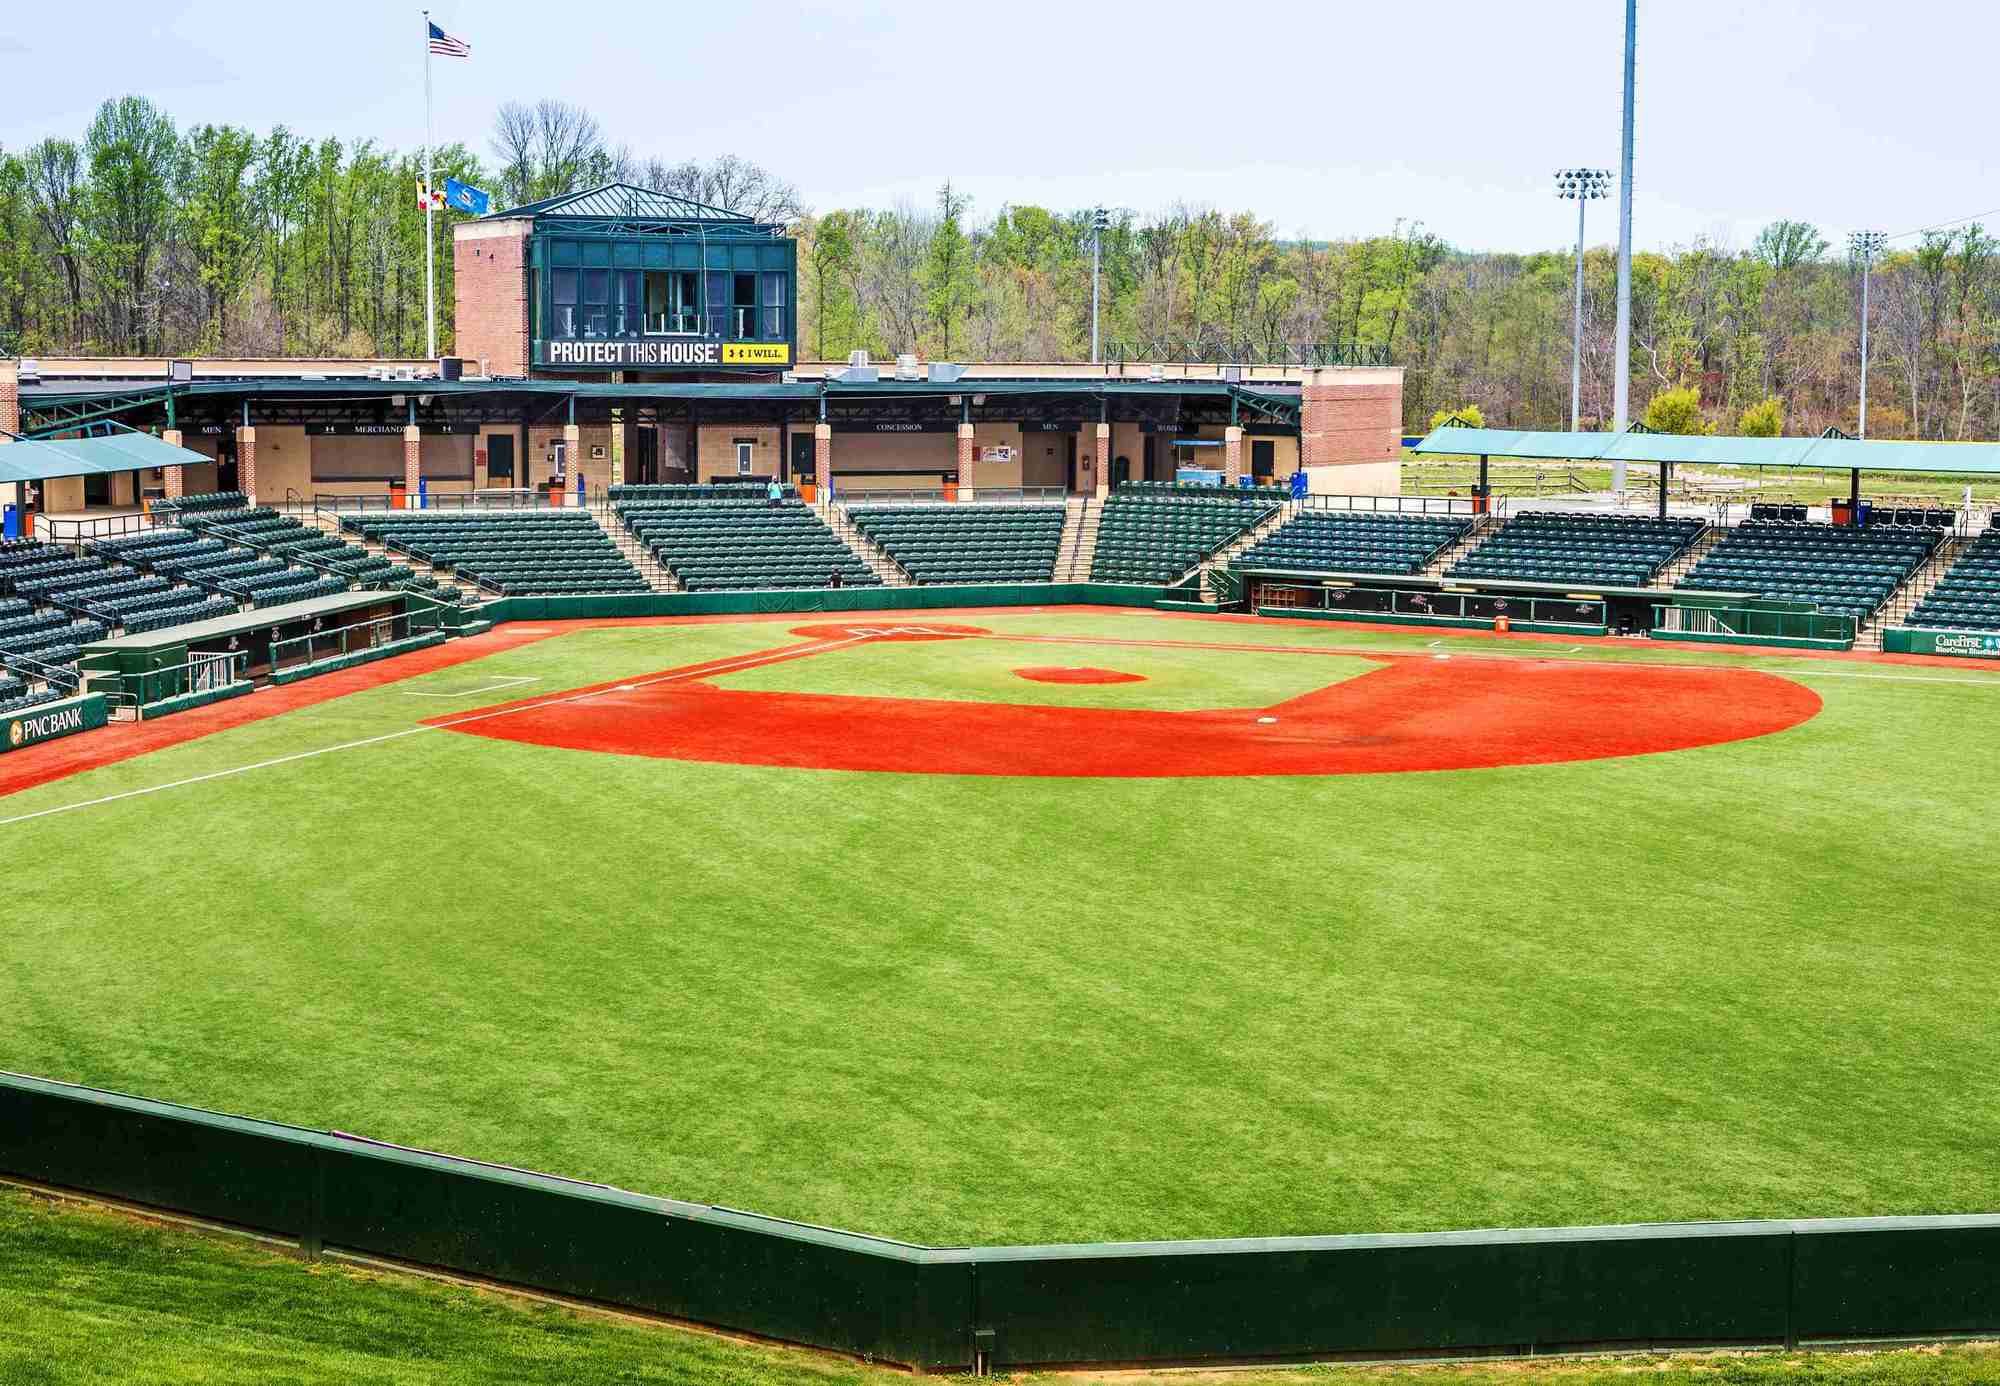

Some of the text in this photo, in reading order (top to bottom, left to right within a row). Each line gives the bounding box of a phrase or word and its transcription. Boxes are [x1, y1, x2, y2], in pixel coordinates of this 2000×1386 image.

[550, 342, 625, 363] PROTECT
[628, 342, 657, 363] THIS
[1935, 634, 1983, 647] CareFirst
[24, 707, 82, 740] PNC BANK
